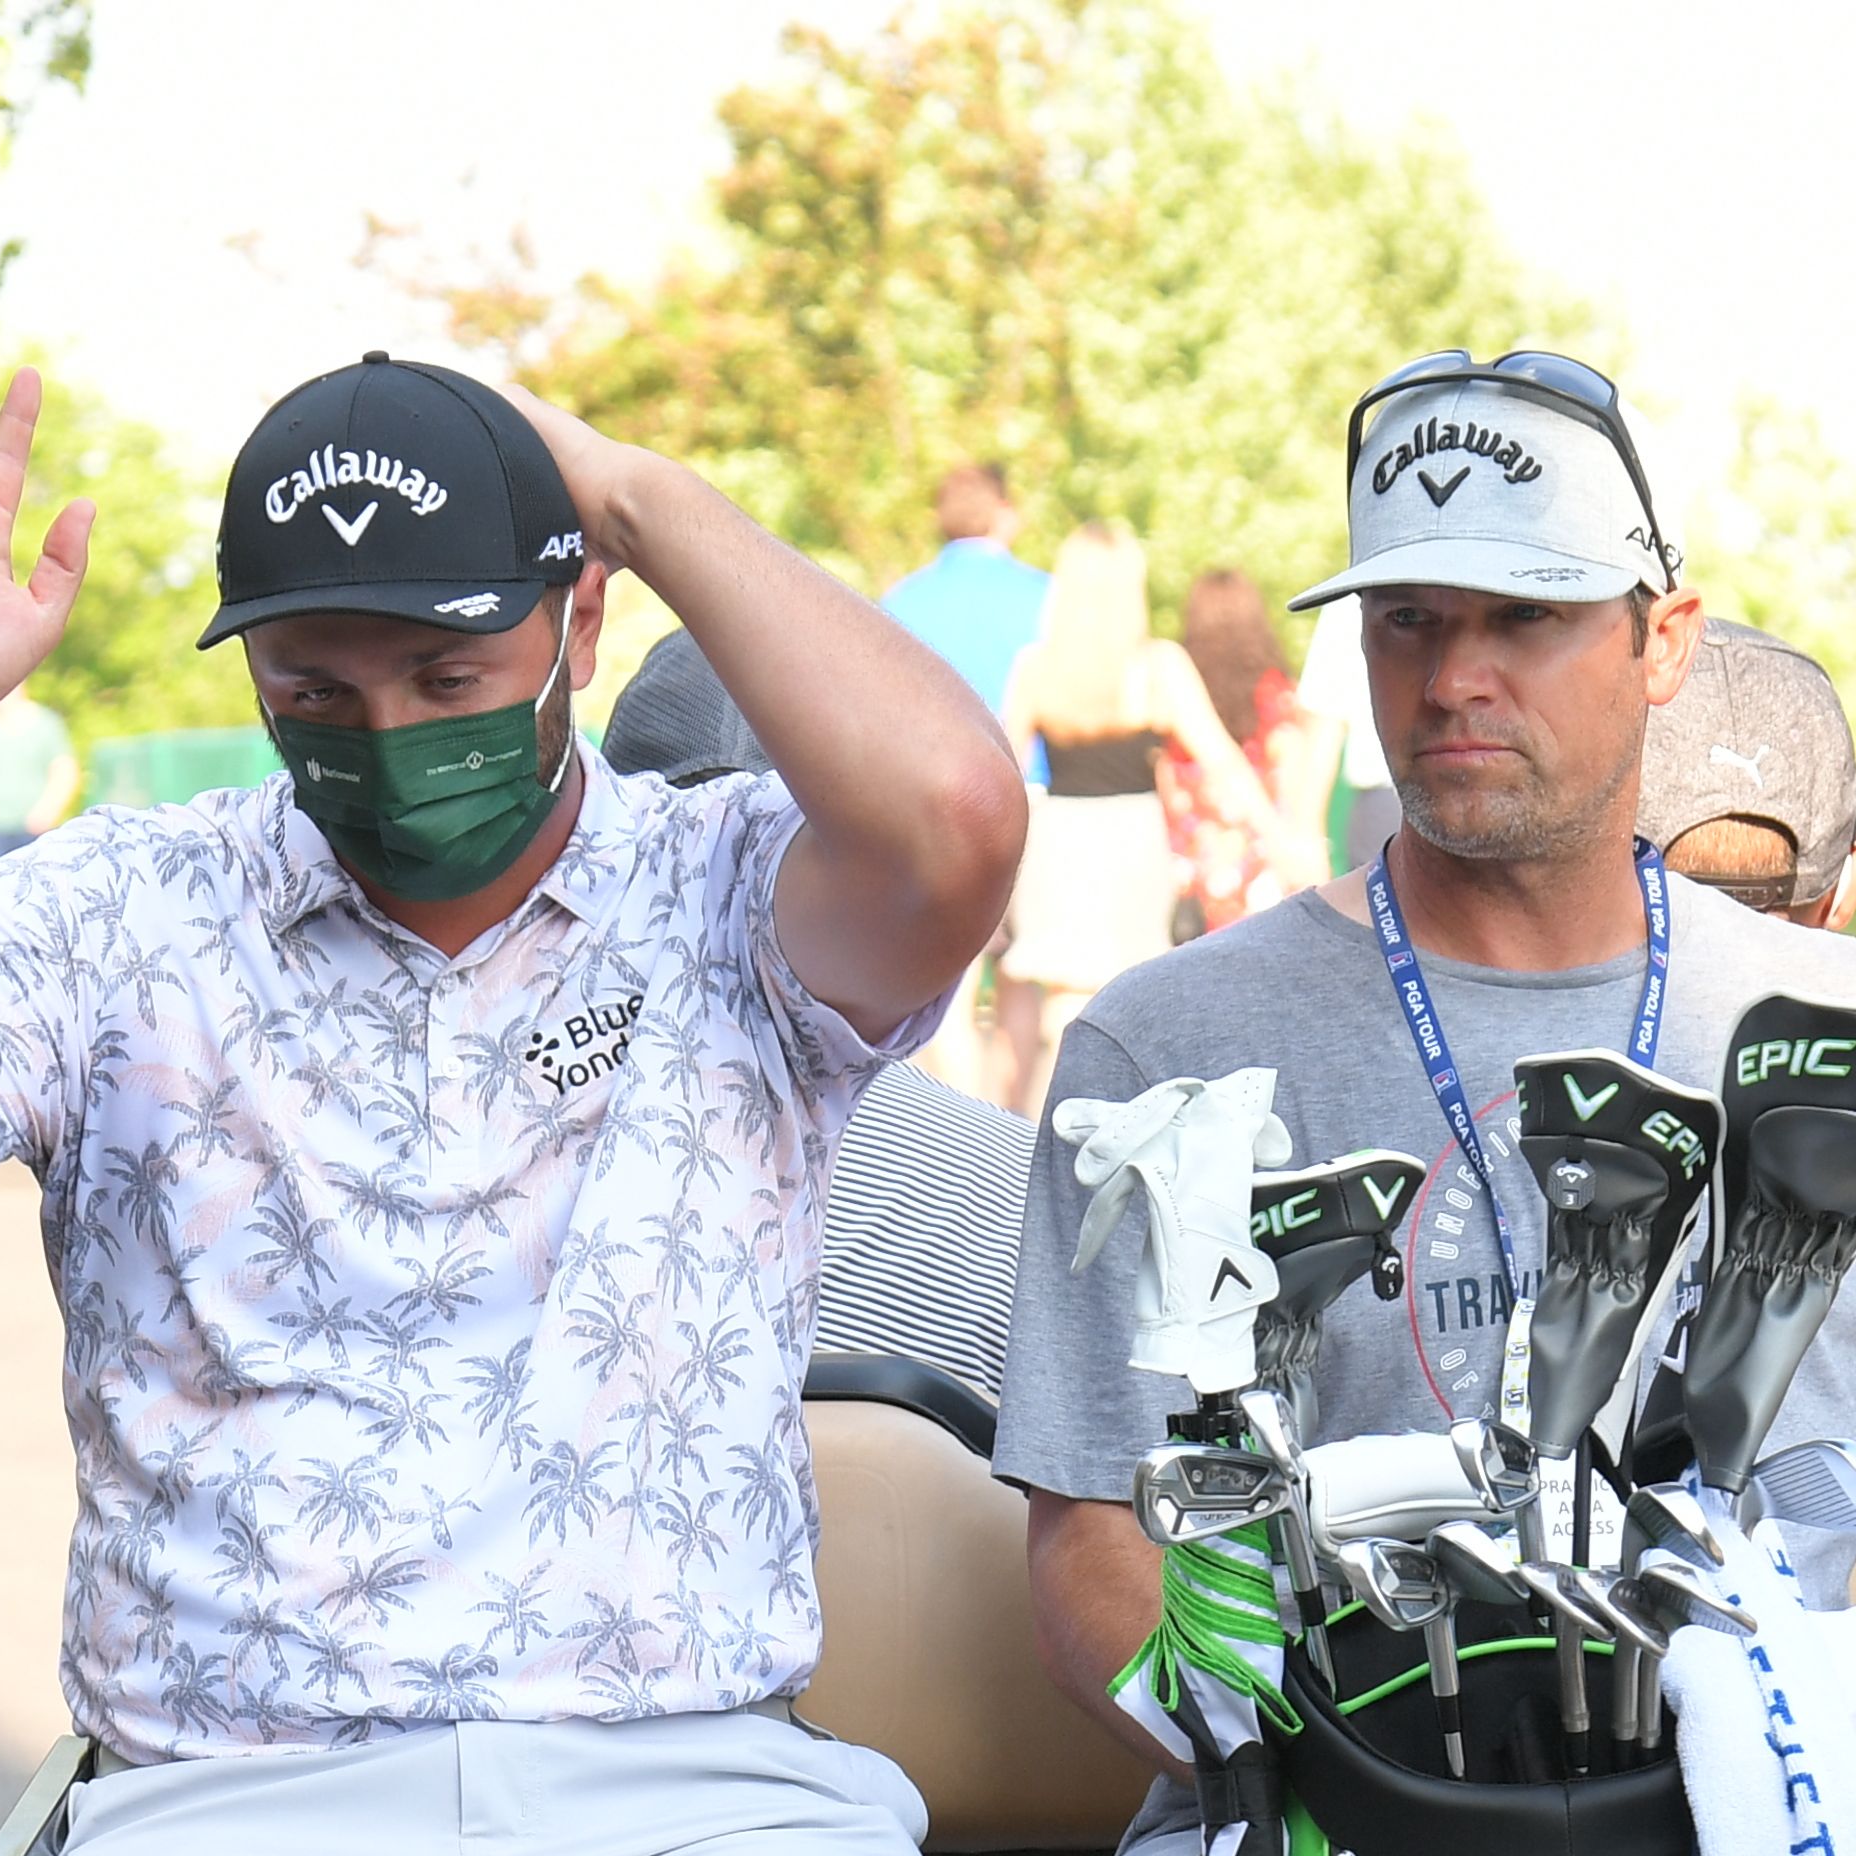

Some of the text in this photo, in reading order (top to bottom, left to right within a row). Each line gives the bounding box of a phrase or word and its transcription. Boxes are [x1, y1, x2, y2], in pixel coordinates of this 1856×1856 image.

[265, 443, 448, 523] Callaway
[1372, 416, 1543, 495] Callaway
[1372, 881, 1401, 945] PGA TOUR
[1644, 868, 1665, 938] PGA TOUR
[564, 994, 644, 1049] Blue
[1403, 980, 1442, 1061] PGA TOUR
[1636, 975, 1662, 1055] PGA TOUR
[540, 1031, 629, 1095] Yond
[1449, 1102, 1470, 1140] PGA
[1250, 1188, 1322, 1248] PIC
[1565, 1194, 1574, 1206] 3
[1539, 1478, 1611, 1494] PRAIC
[1558, 1500, 1604, 1515] AA
